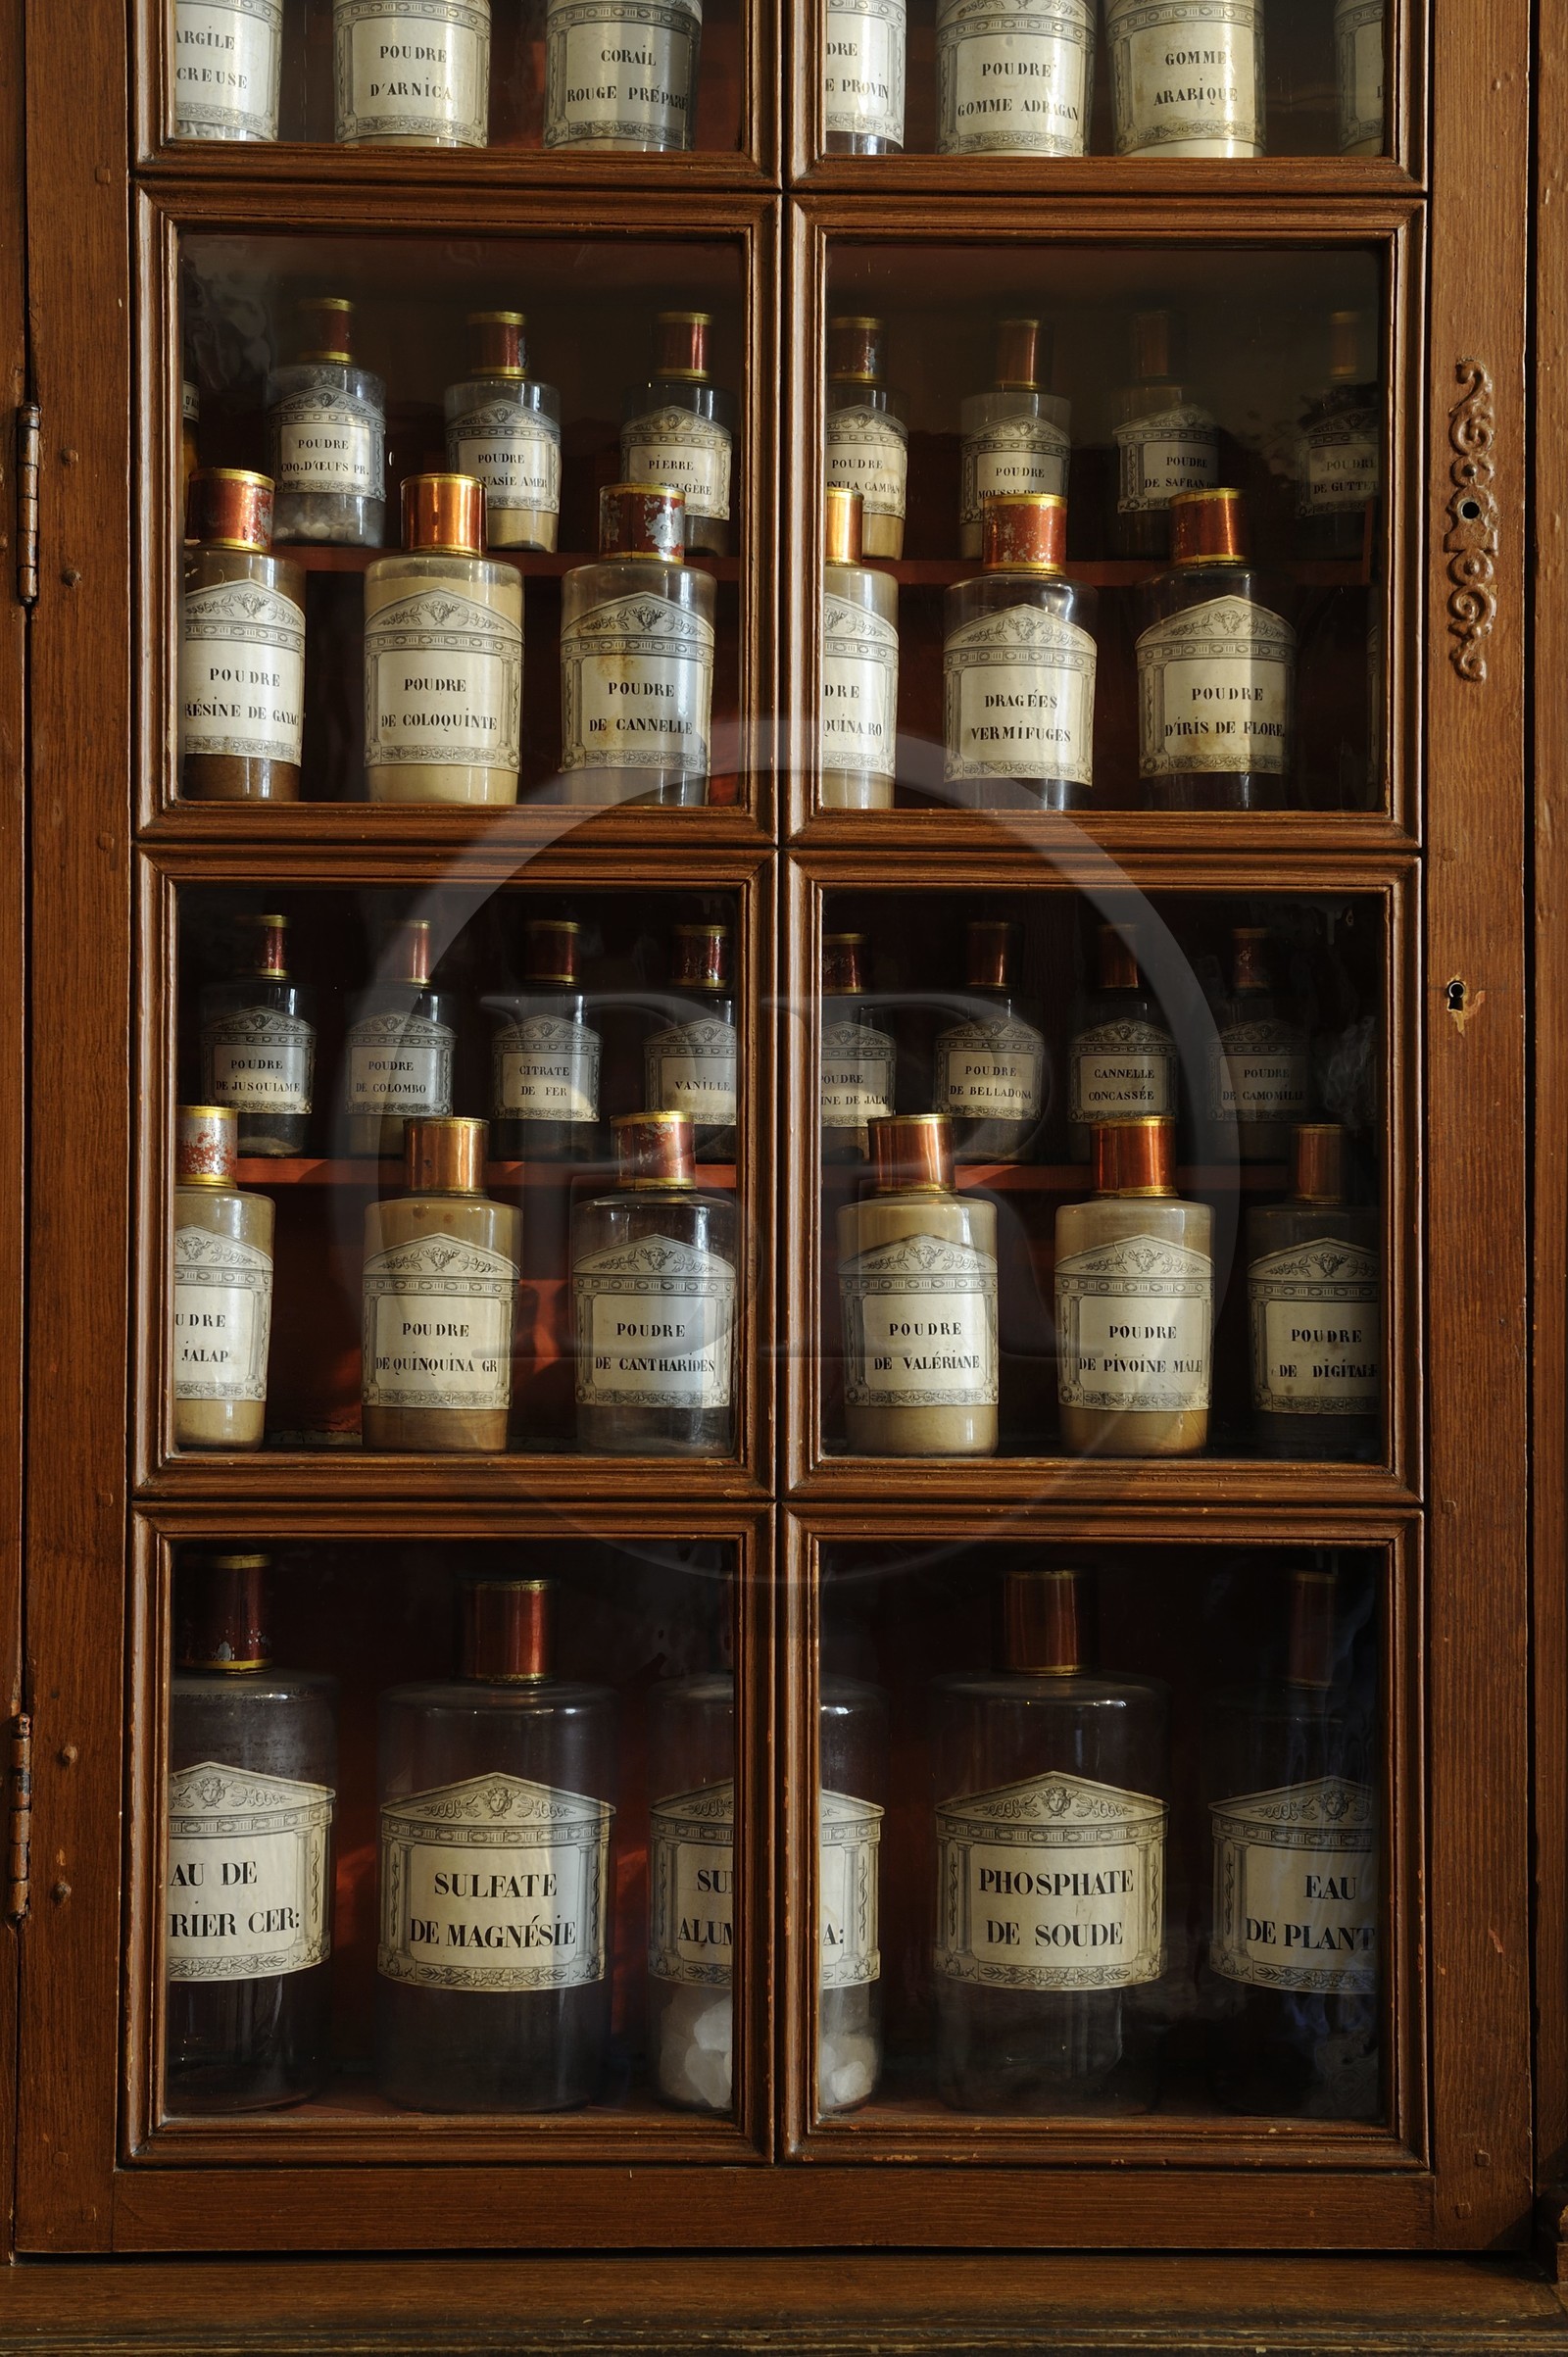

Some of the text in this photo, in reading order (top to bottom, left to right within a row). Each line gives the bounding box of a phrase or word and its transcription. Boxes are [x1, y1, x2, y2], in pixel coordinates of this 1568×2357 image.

[379, 45, 448, 63] POUDRE
[601, 44, 657, 66] CORAIL
[1164, 51, 1227, 66] GOMME
[982, 62, 1053, 77] POUDRE
[176, 67, 247, 89] CREUSE
[370, 77, 454, 100] D'ARNICA
[567, 85, 617, 103] ROUGE
[1152, 77, 1239, 106] ARABIQUE
[957, 98, 1012, 117] GOMME
[298, 439, 350, 450] POUDRE
[478, 454, 524, 465] POUDRE
[648, 454, 694, 470] PIERRE
[832, 459, 883, 469] POUDRE
[1166, 457, 1207, 468] POUDRE
[1326, 459, 1377, 471] POUDRE
[996, 467, 1045, 478] POUDRE
[1146, 479, 1159, 488] DE
[1166, 477, 1205, 489] SAFRAN
[1313, 484, 1327, 495] DE
[210, 667, 280, 687] POUDRE
[404, 678, 466, 693] POUDRE
[609, 681, 675, 698] POUDRE
[824, 684, 859, 699] DRE
[985, 688, 1059, 710] DRAGÉES
[1192, 687, 1263, 702] POUDRE
[248, 706, 267, 720] DE
[382, 707, 498, 732] DE COLOQUINTE
[590, 718, 693, 735] DE CANNELLE
[971, 720, 1071, 744] VERMIFUGES
[1165, 715, 1208, 738] D'IRIS
[1216, 720, 1236, 735] DE
[231, 1059, 283, 1070] POUDRE
[368, 1061, 414, 1072] POUDRE
[519, 1058, 570, 1077] CITRATE
[965, 1065, 1017, 1077] POUDRE
[1094, 1068, 1154, 1079] CANNELLE
[1244, 1068, 1291, 1079] POUDRE
[216, 1074, 300, 1095] DE JUSQUIAME
[357, 1082, 427, 1095] DE COLOMBO
[521, 1086, 567, 1098] DE FER
[675, 1077, 731, 1092] VANILLE
[950, 1085, 1032, 1100] DE BELLADONA
[846, 1096, 860, 1105] DE
[1088, 1085, 1154, 1102] CONCASSÉE
[1222, 1091, 1236, 1101] DE
[403, 1322, 469, 1338] POUDRE
[616, 1322, 686, 1338] POUDRE
[889, 1322, 961, 1337] POUDRE
[1108, 1324, 1176, 1339] POUDRE
[1291, 1328, 1362, 1344] POUDRE
[182, 1340, 229, 1363] JALAP
[874, 1349, 980, 1370] DE VALÉRIANE
[376, 1356, 391, 1371] DE
[393, 1351, 474, 1377] QUINQUINA
[595, 1353, 716, 1372] DE CANTHARIDES
[1078, 1358, 1096, 1371] DE
[1103, 1351, 1166, 1373] PIVOINE
[1279, 1364, 1298, 1378] DE
[170, 1862, 258, 1887] AU DE
[697, 1869, 734, 1893] SU
[980, 1869, 1134, 1895] PHOSPHATE
[435, 1872, 558, 1898] SULFATE
[1303, 1875, 1357, 1899] EAU
[248, 1906, 301, 1935] CER:
[411, 1914, 576, 1948] DE MAGNÉSIE
[987, 1920, 1124, 1947] DE SOUDE
[1246, 1918, 1375, 1951] DE PLANT
